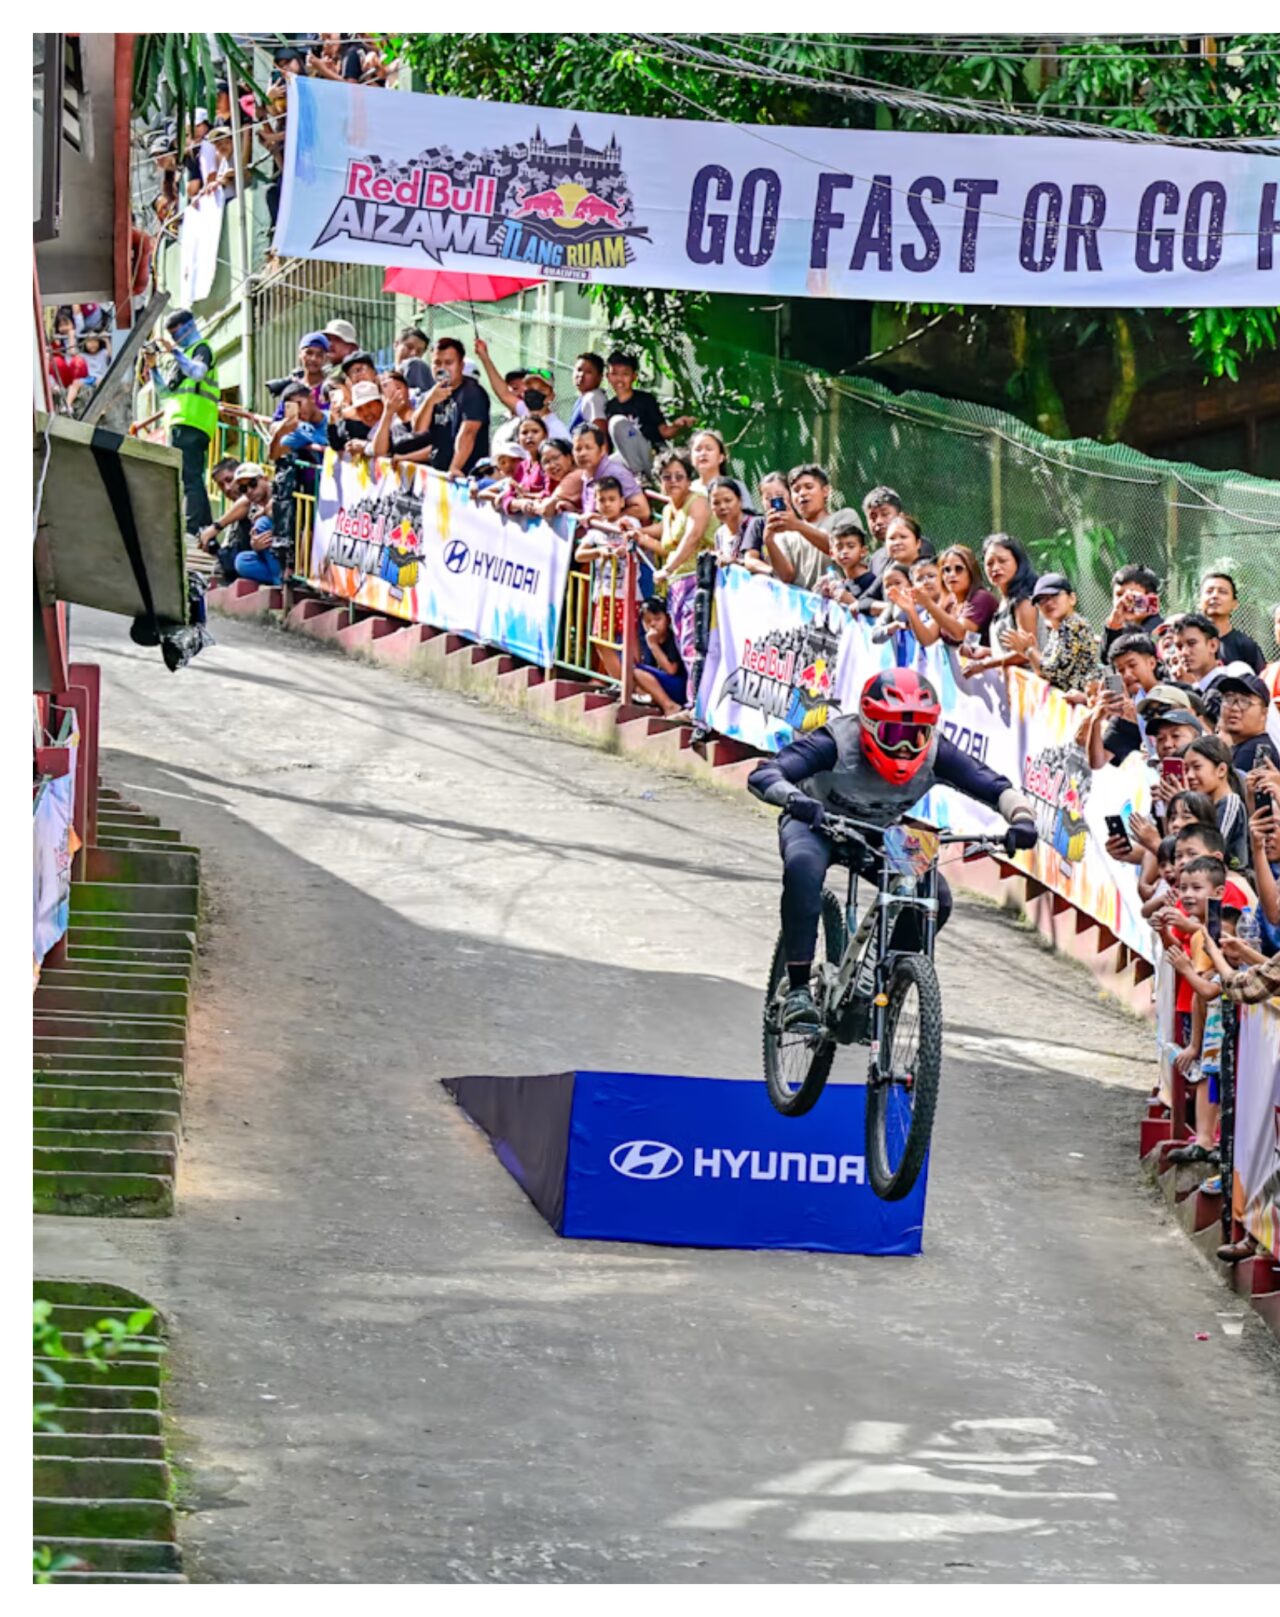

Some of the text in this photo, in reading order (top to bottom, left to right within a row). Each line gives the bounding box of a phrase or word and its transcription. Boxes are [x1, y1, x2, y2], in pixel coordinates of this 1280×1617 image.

[347, 161, 494, 214] Red Bull
[311, 196, 498, 265] AIZAWL
[685, 163, 783, 268] GO
[808, 171, 998, 274] FAST
[1018, 180, 1107, 273] OR
[1134, 179, 1227, 273] GO
[500, 218, 627, 268] TLANG RUAM
[335, 507, 360, 537] Red
[472, 550, 541, 595] HYUNDAI
[742, 638, 795, 684] Red Bull
[694, 1148, 871, 1185] HYUNDA
